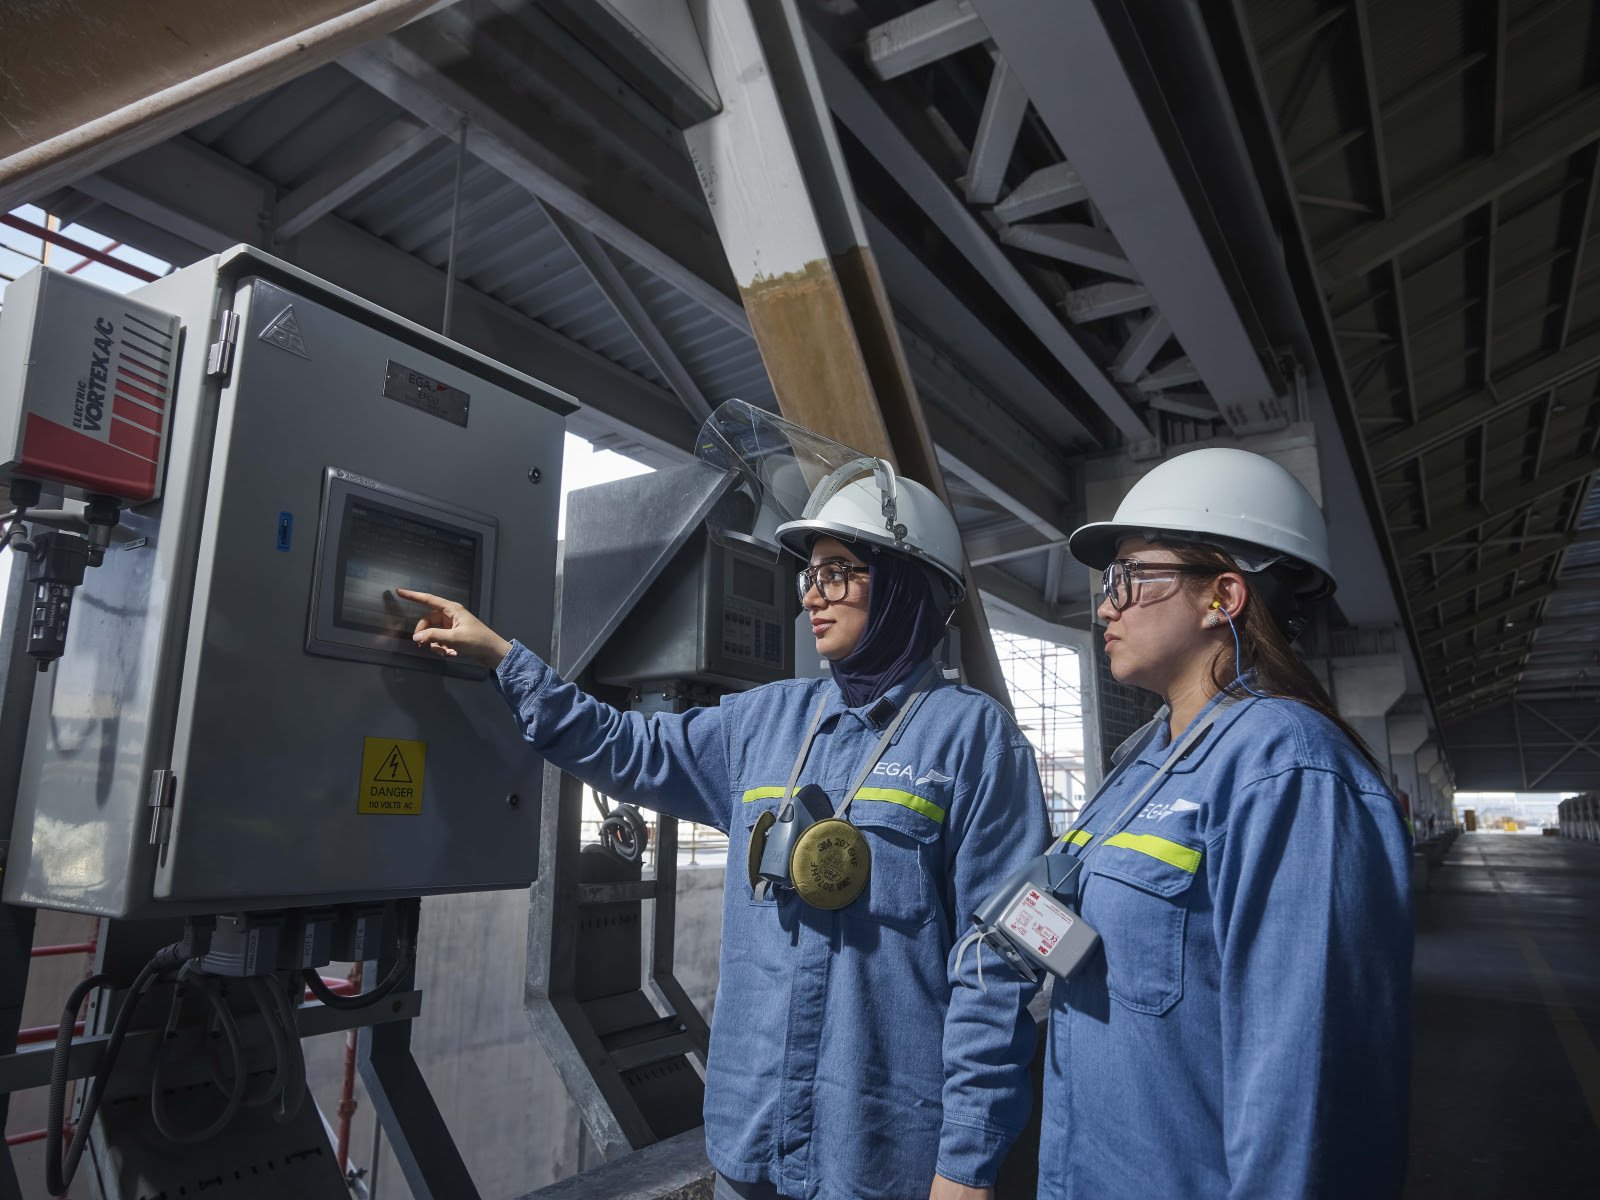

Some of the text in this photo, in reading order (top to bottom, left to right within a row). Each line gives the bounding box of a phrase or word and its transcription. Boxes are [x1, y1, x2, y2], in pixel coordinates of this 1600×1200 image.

[83, 317, 114, 432] VORTEX A/C
[409, 373, 431, 391] EGA
[72, 380, 87, 429] ELECTRIC
[872, 761, 914, 781] EGA
[370, 786, 414, 798] DANGER
[368, 801, 413, 810] 110 VOLTS AC
[1137, 803, 1170, 820] EGA
[1029, 890, 1040, 901] 3M
[1037, 945, 1049, 955] 3M
